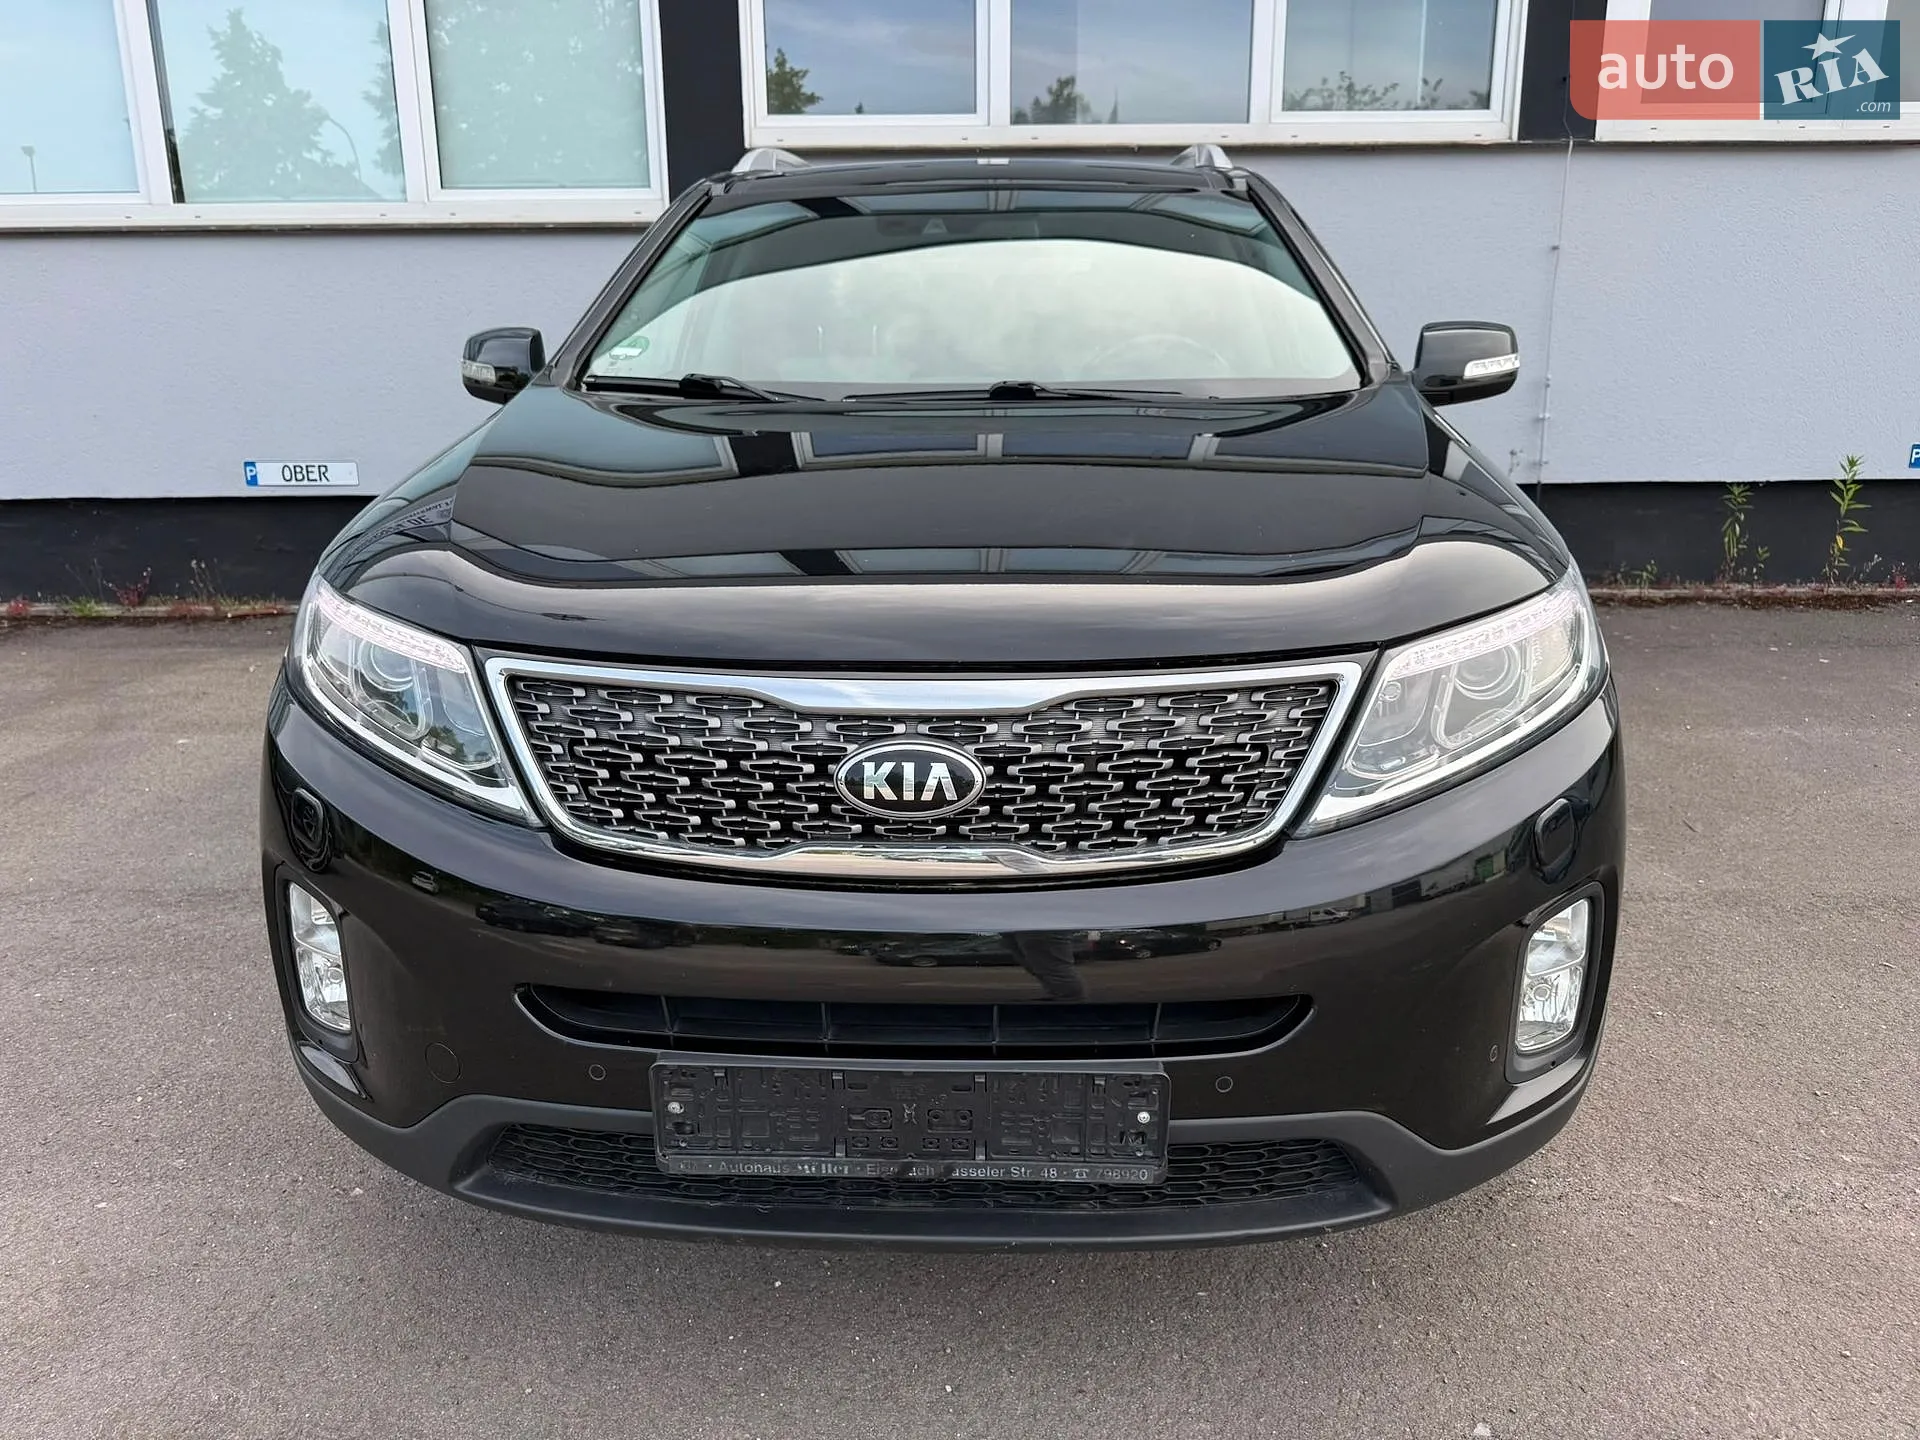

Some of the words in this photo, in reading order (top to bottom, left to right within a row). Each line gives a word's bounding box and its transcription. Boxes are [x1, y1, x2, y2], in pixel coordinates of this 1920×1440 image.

[246, 466, 257, 481] P
[281, 464, 330, 482] OBER
[862, 761, 958, 801] KIA
[940, 1165, 1006, 1178] asseler
[1040, 1167, 1058, 1179] 48
